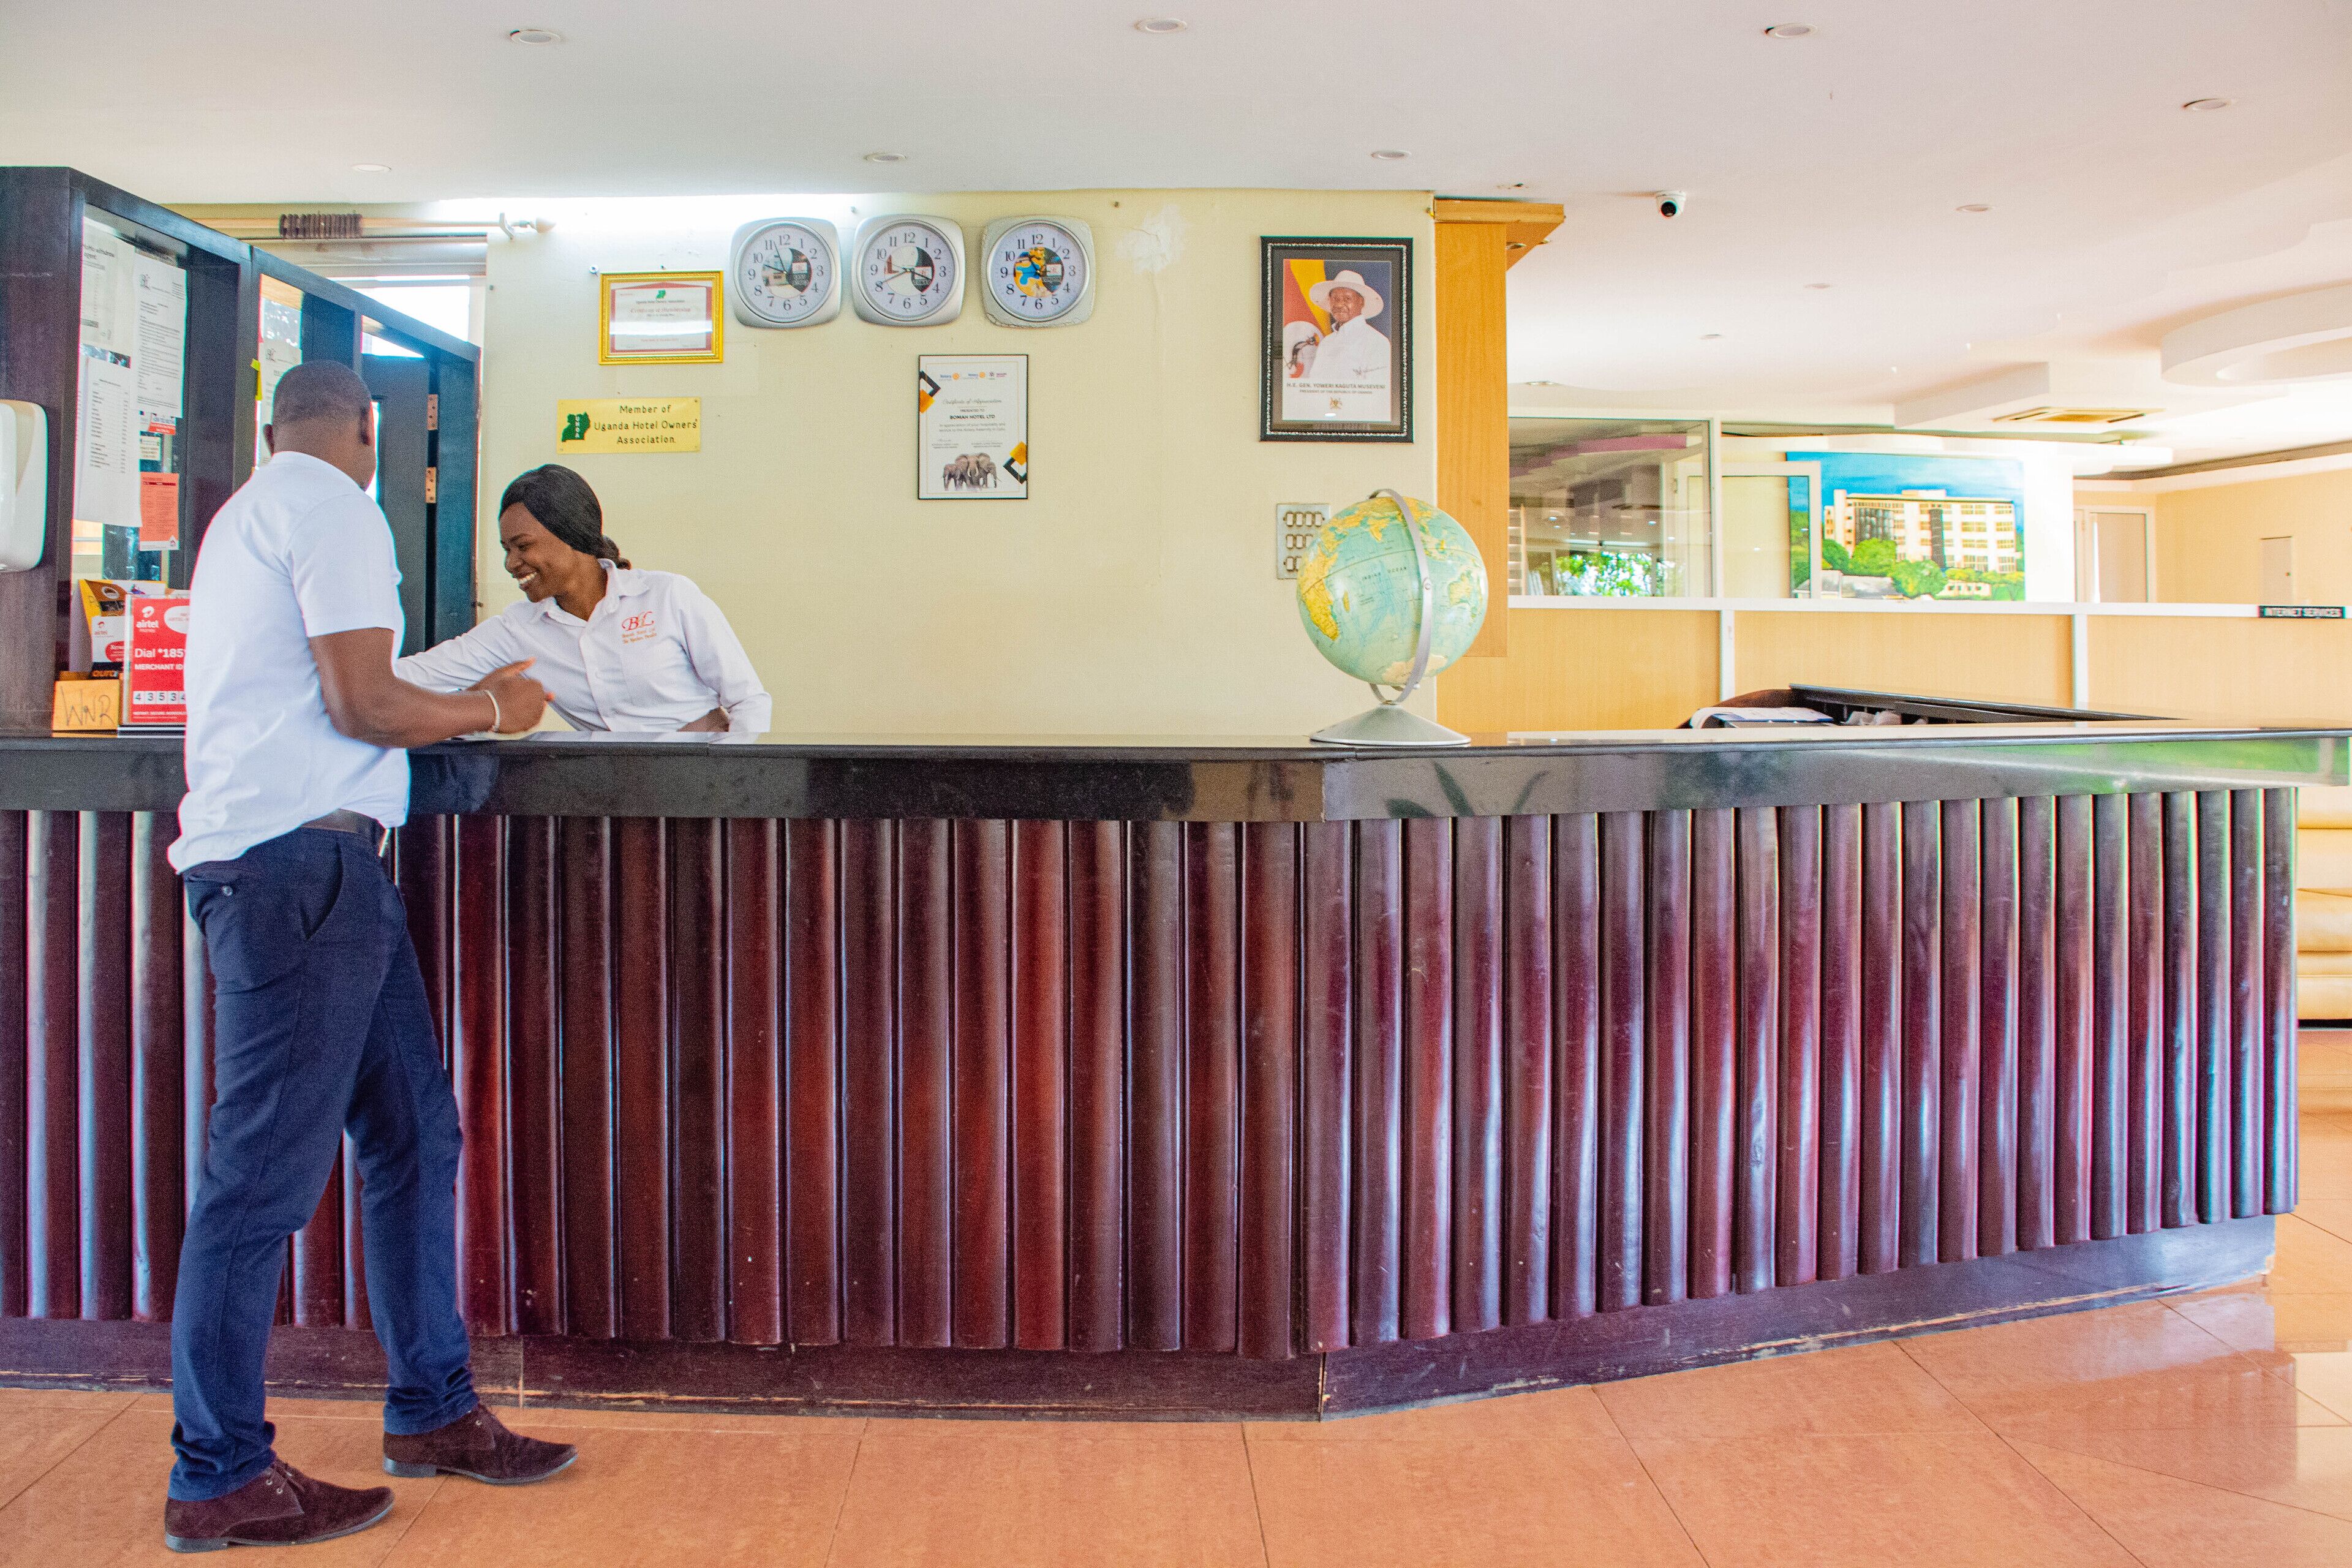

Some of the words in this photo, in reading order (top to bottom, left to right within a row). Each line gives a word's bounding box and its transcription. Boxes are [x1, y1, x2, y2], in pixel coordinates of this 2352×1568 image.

[779, 234, 790, 245] 12
[800, 238, 804, 248] 1
[890, 236, 897, 246] 11
[905, 233, 915, 243] 12
[925, 238, 928, 247] 1
[1032, 234, 1043, 244] 12
[1052, 238, 1055, 247] 1
[765, 239, 772, 250] 11
[1017, 239, 1025, 249] 11
[753, 252, 763, 263] 10
[810, 248, 817, 259] 2
[877, 248, 887, 260] 10
[934, 248, 941, 260] 2
[1006, 251, 1016, 262] 10
[1063, 248, 1069, 259] 2
[748, 268, 756, 280] 9
[816, 265, 823, 276] 3
[870, 265, 878, 276] 9
[939, 266, 946, 277] 3
[1000, 266, 1008, 278] 9
[1069, 265, 1076, 276] 3
[754, 285, 762, 296] 8
[811, 282, 818, 293] 4
[875, 281, 883, 292] 8
[933, 282, 939, 293] 4
[1006, 284, 1014, 295] 8
[1063, 282, 1070, 293] 4
[767, 296, 774, 306] 7
[799, 295, 807, 306] 5
[888, 292, 895, 304] 7
[903, 298, 911, 309] 6
[920, 295, 927, 306] 5
[1020, 295, 1027, 306] 7
[1035, 298, 1042, 309] 6
[1051, 294, 1058, 305] 5
[783, 300, 791, 311] 6
[619, 405, 657, 413] Member
[594, 422, 629, 431] Uganda
[633, 421, 658, 430] Hotel
[136, 620, 159, 628] airtel
[134, 648, 156, 658] Dial
